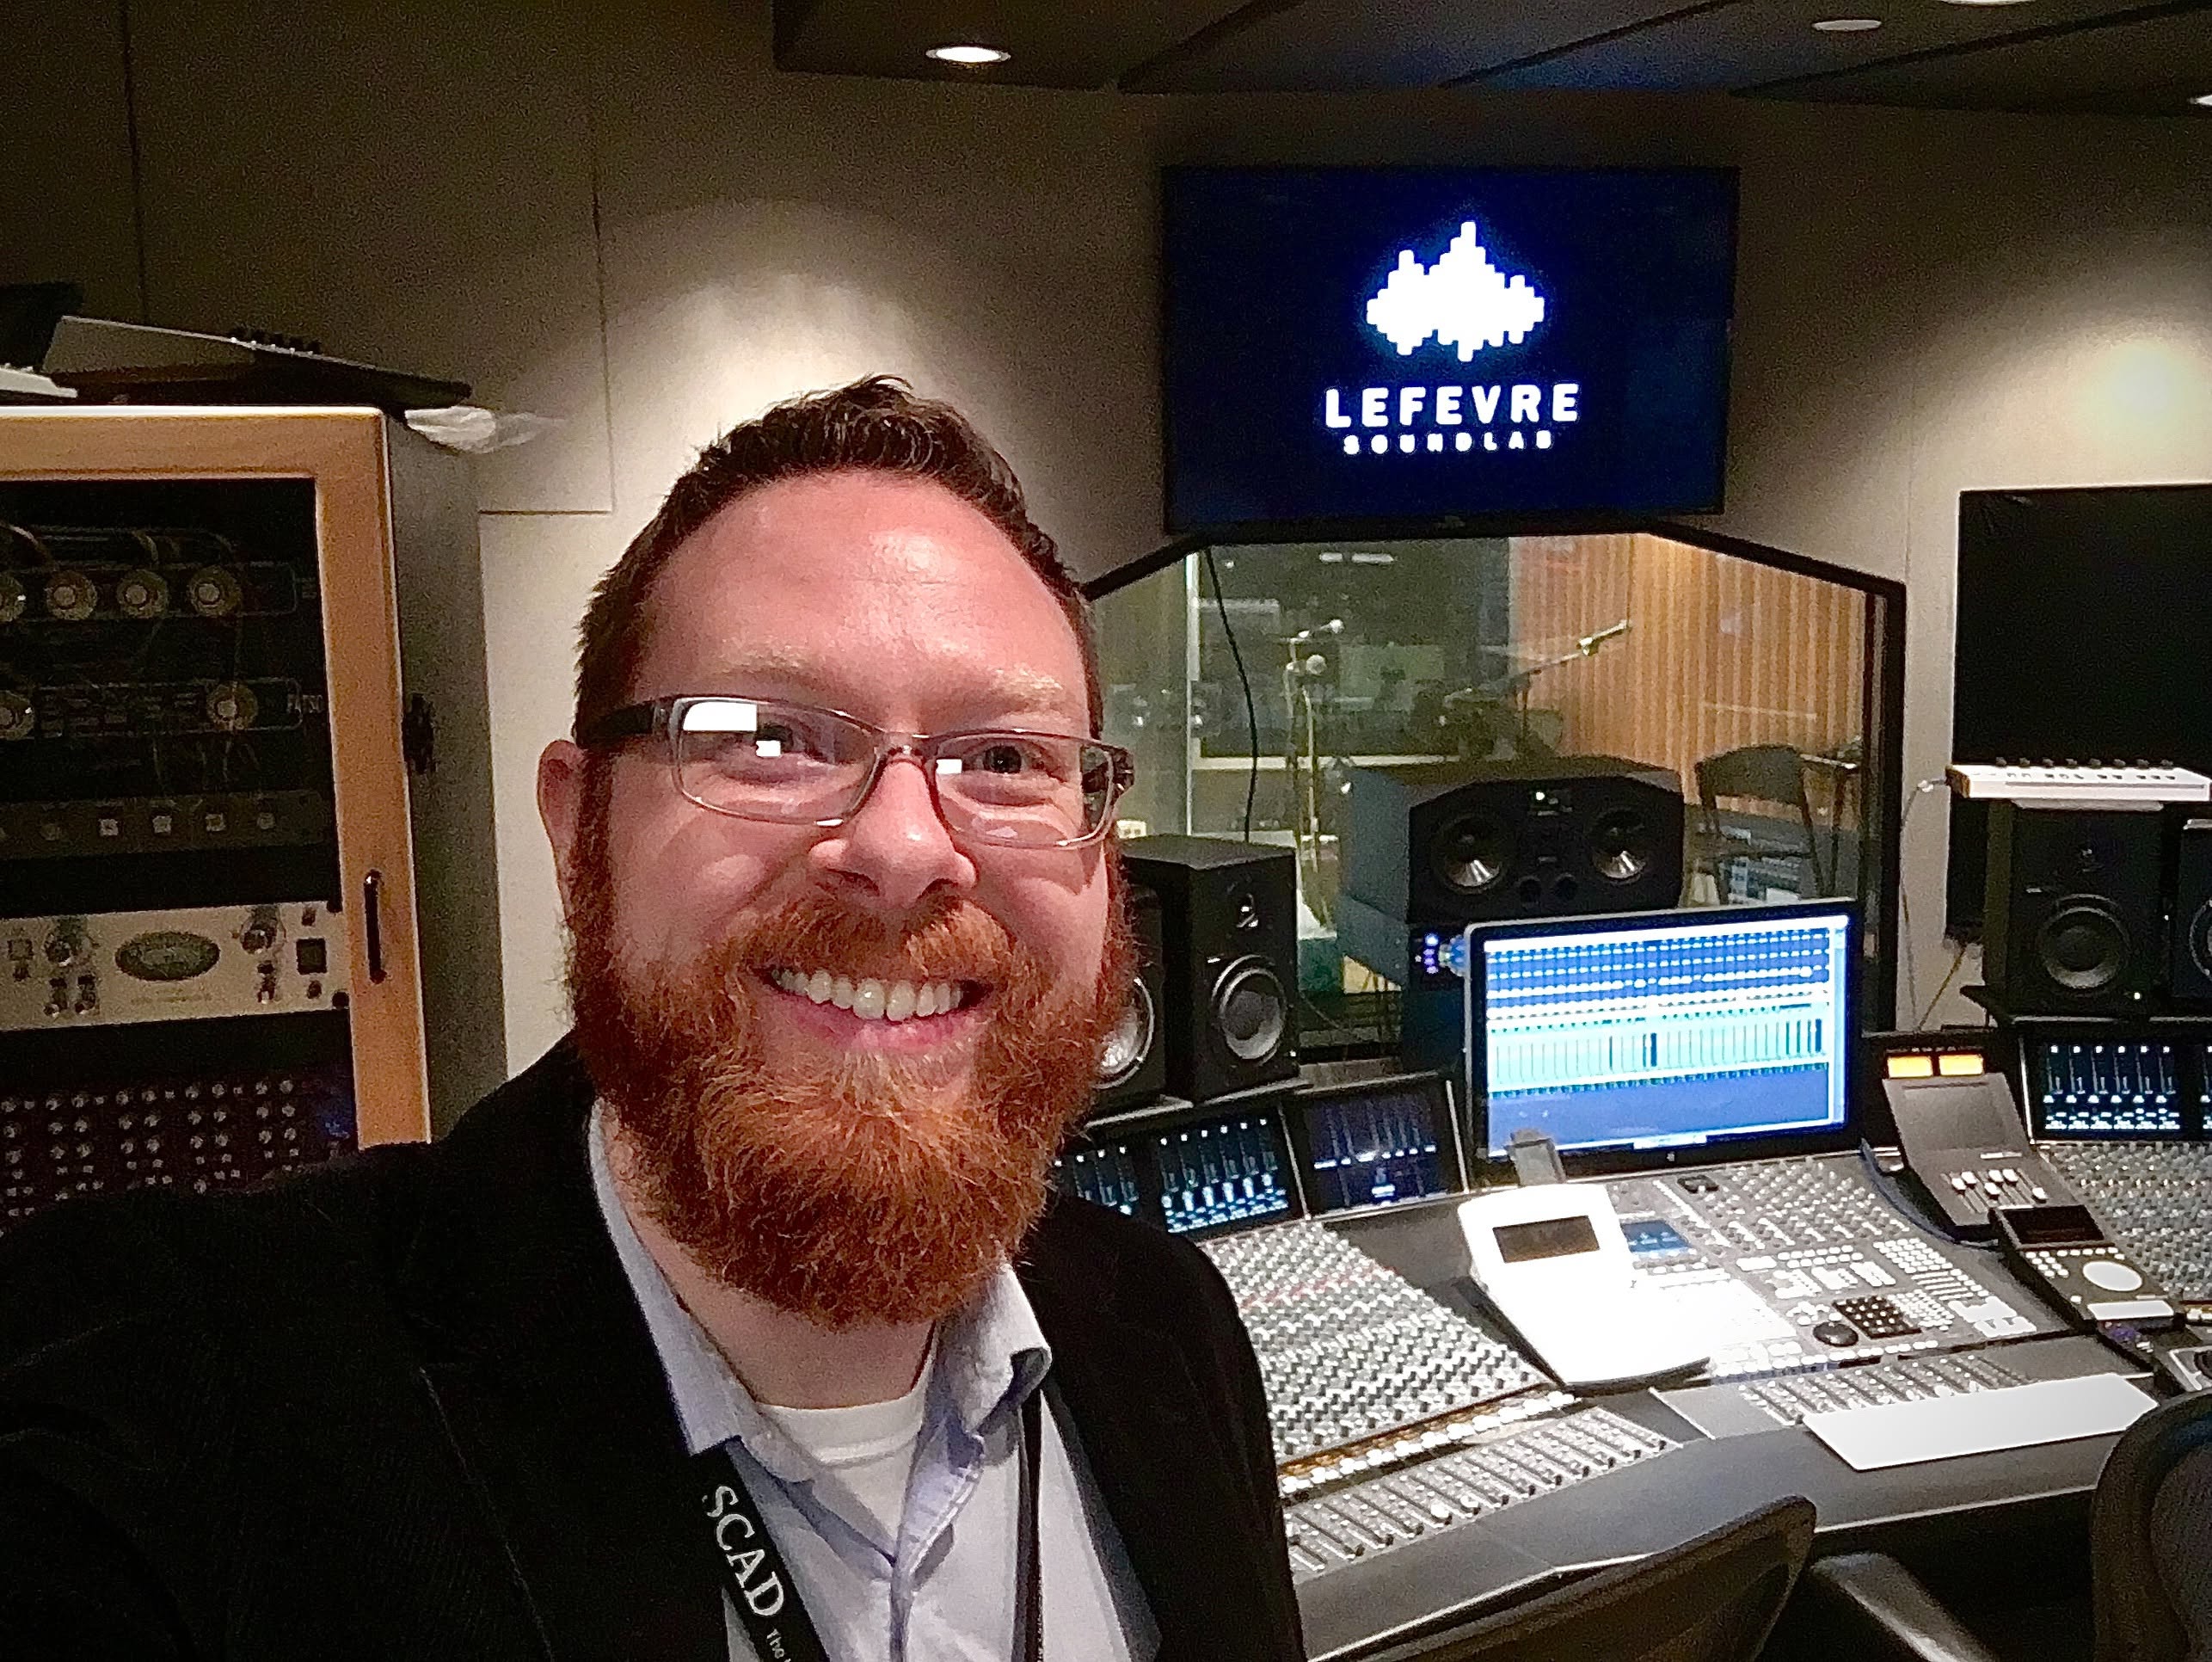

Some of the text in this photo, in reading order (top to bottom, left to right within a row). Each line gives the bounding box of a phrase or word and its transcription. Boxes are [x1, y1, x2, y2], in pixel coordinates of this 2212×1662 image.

[1325, 384, 1579, 428] LEFEVRE
[1343, 430, 1551, 454] SOUNDLAB
[702, 1486, 783, 1616] SCAD
